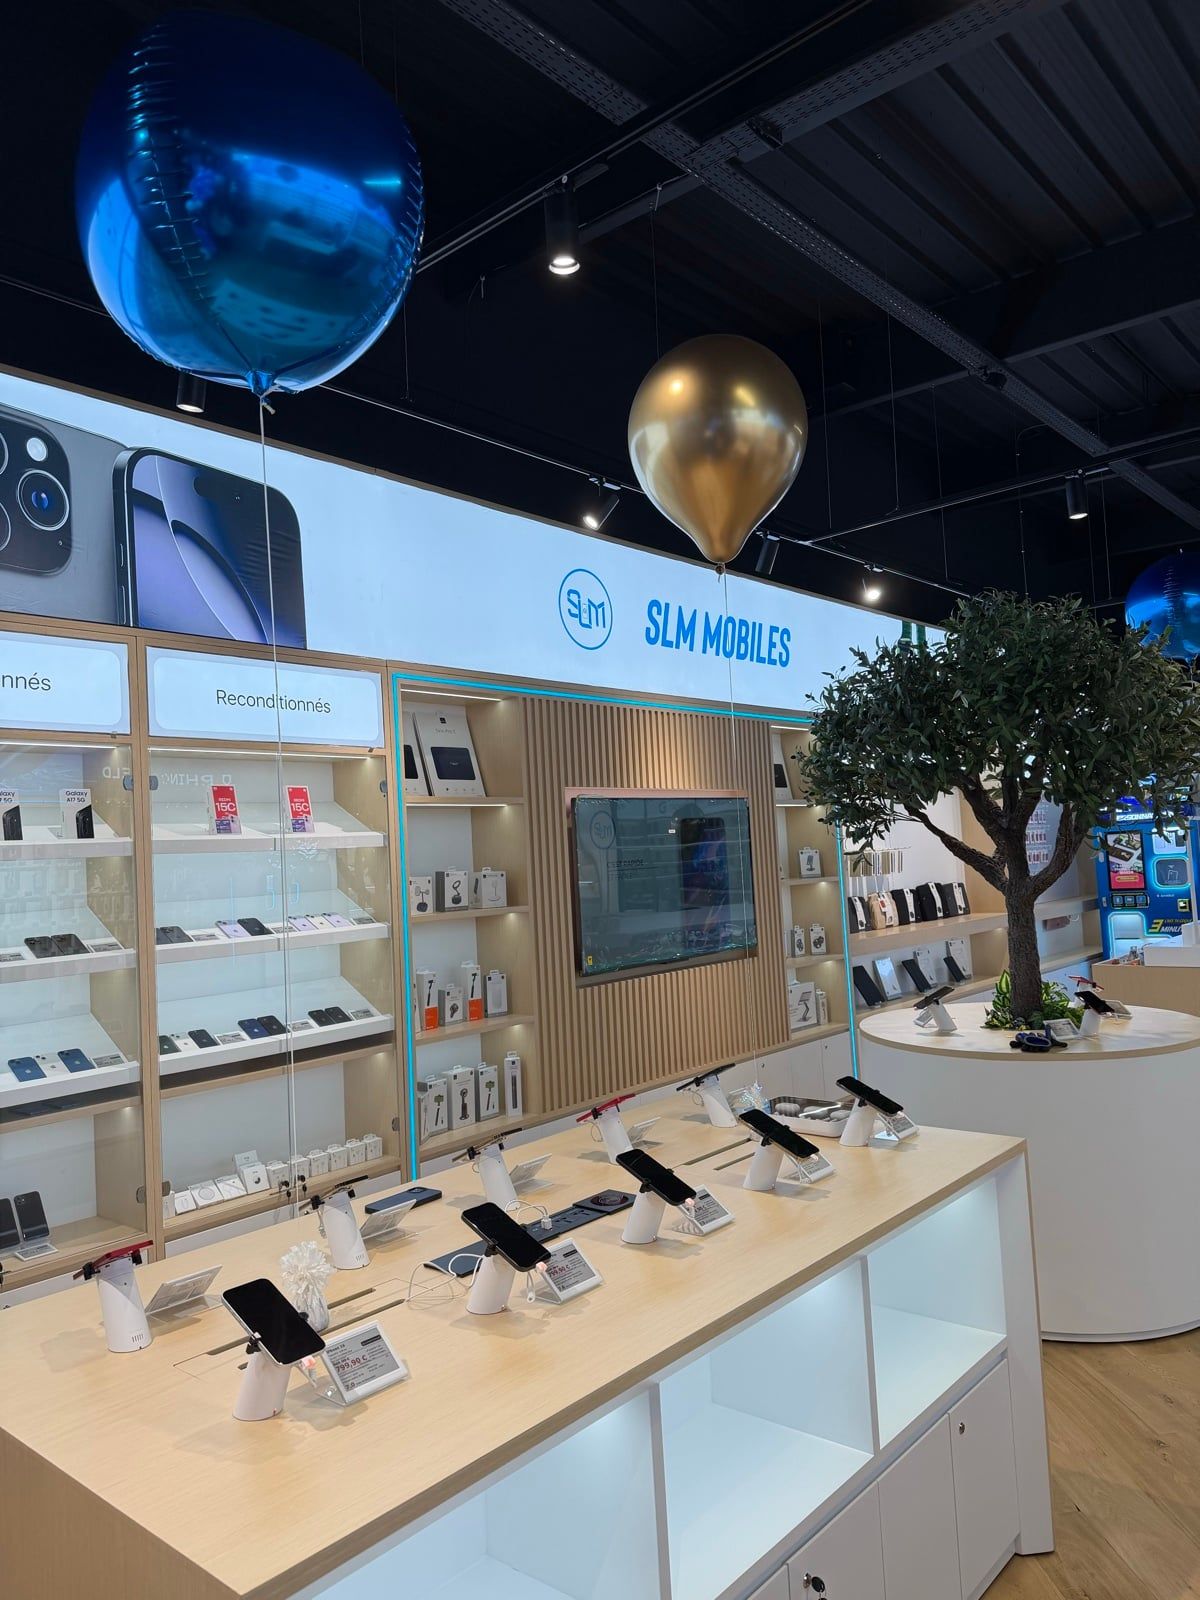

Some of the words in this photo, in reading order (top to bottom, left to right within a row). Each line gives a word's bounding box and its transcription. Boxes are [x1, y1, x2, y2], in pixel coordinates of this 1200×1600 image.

[567, 588, 606, 629] SLM
[645, 599, 697, 652] SLM
[702, 611, 791, 668] MOBILES
[215, 689, 331, 713] Reconditionnés
[215, 802, 236, 812] 15C
[290, 802, 310, 812] 15C
[1148, 919, 1165, 933] 3
[1160, 925, 1181, 933] MINU
[336, 1357, 361, 1373] 799,90
